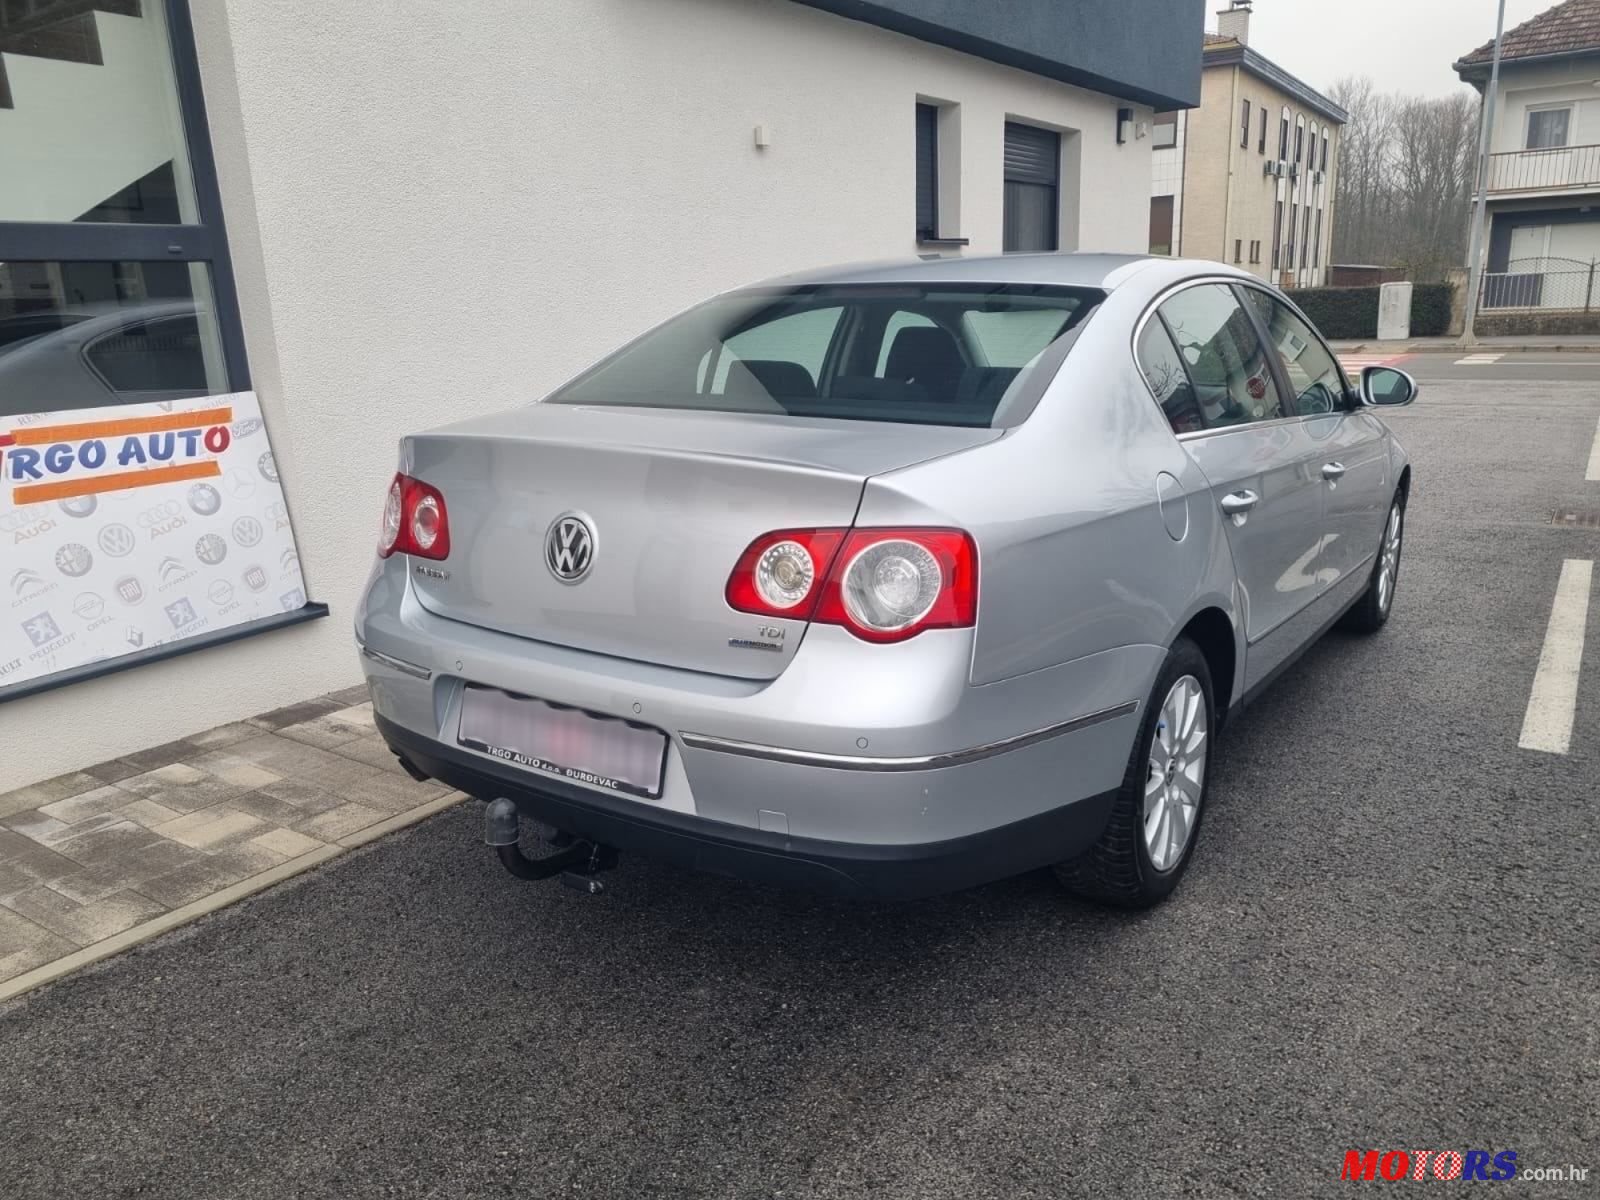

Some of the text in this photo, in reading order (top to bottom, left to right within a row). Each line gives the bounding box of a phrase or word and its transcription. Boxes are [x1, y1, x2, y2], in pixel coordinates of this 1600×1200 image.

[118, 425, 230, 466] AUTO
[14, 519, 57, 545] Audi
[758, 625, 786, 640] TDI
[29, 631, 78, 662] PEUGEOT
[487, 745, 512, 760] TRGO
[513, 754, 541, 769] AUTO
